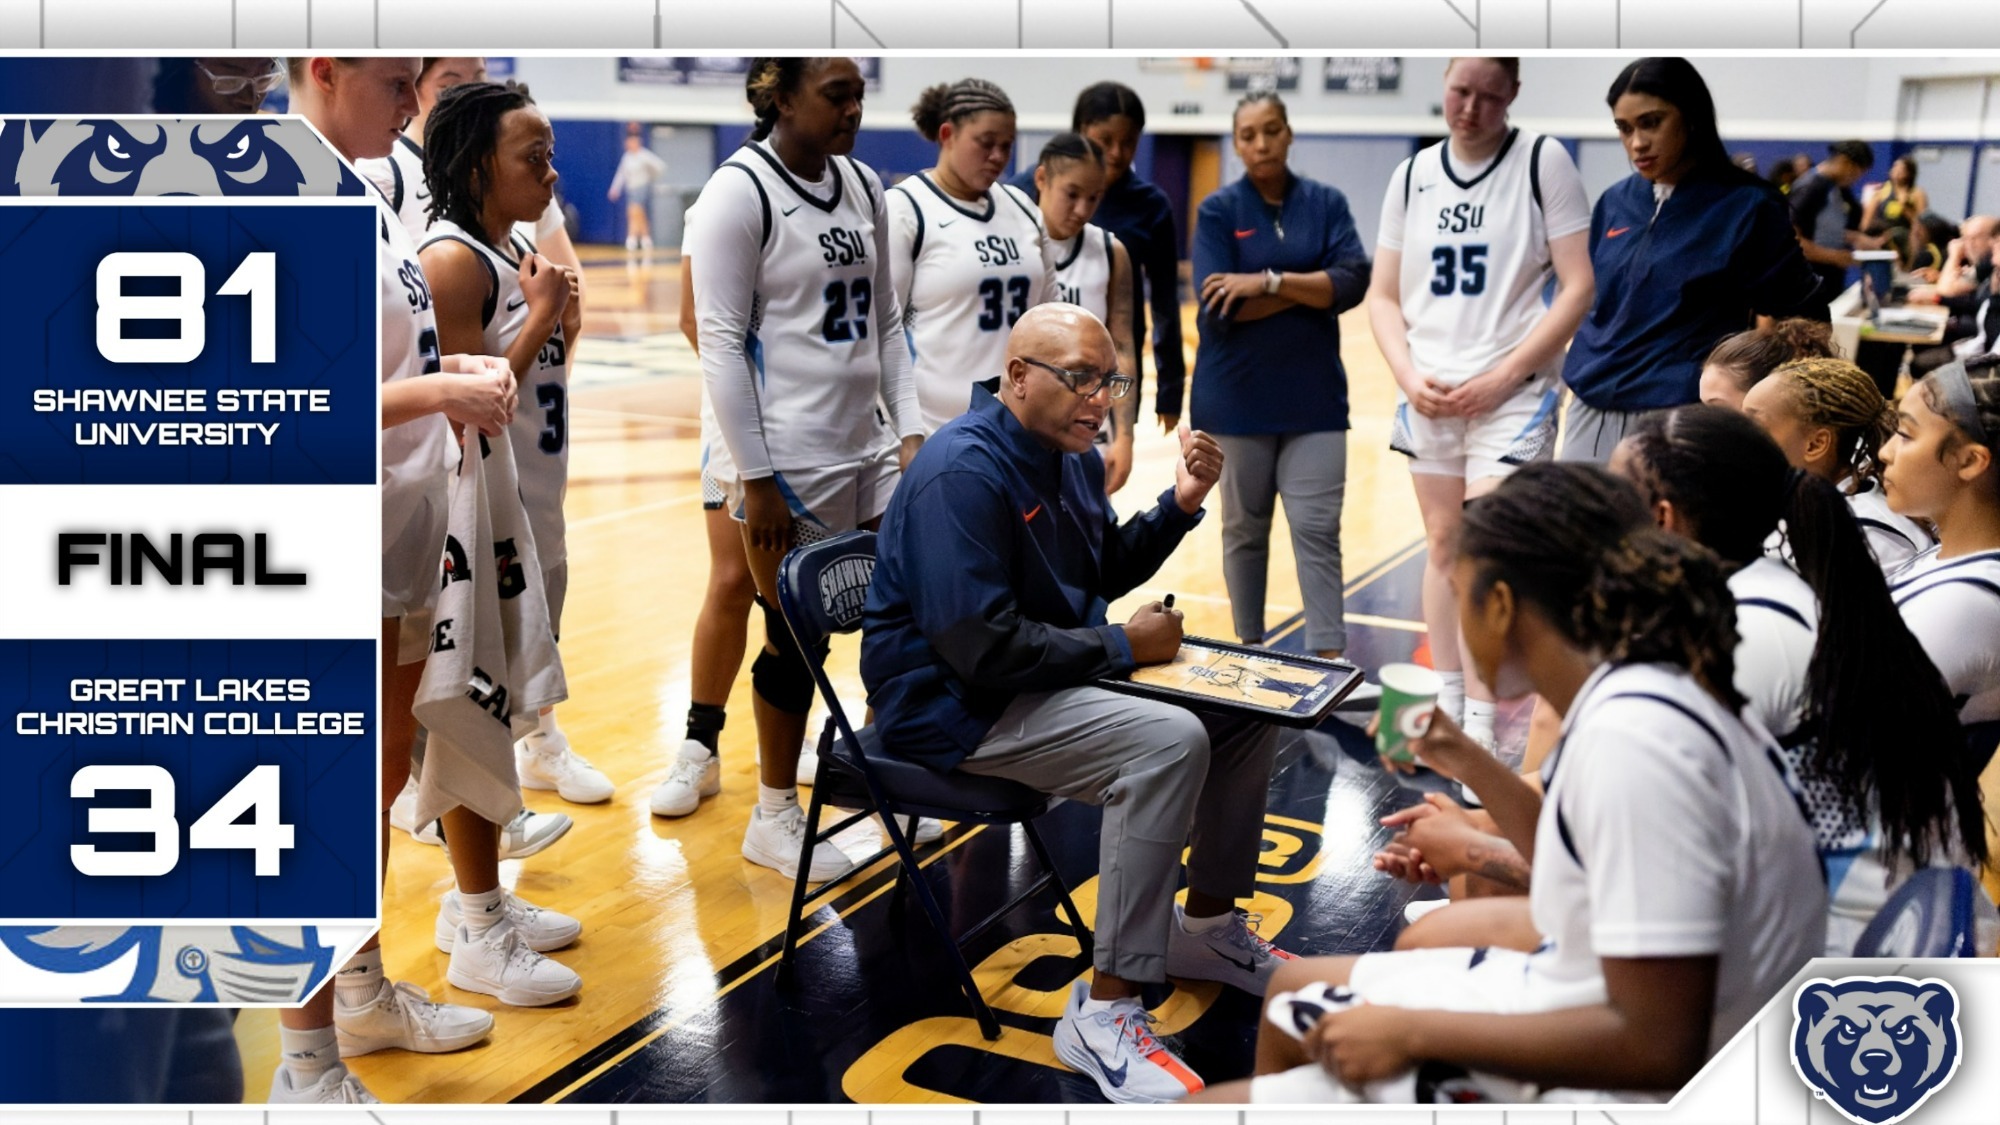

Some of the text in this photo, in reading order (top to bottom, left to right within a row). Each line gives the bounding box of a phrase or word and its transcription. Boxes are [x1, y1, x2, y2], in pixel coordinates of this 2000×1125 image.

[1437, 202, 1485, 233] SSU
[818, 226, 866, 266] SSU
[974, 234, 1020, 266] SSU
[1430, 244, 1489, 296] 35
[822, 276, 871, 344] 23
[978, 275, 1031, 332] 33
[535, 381, 567, 455] 3
